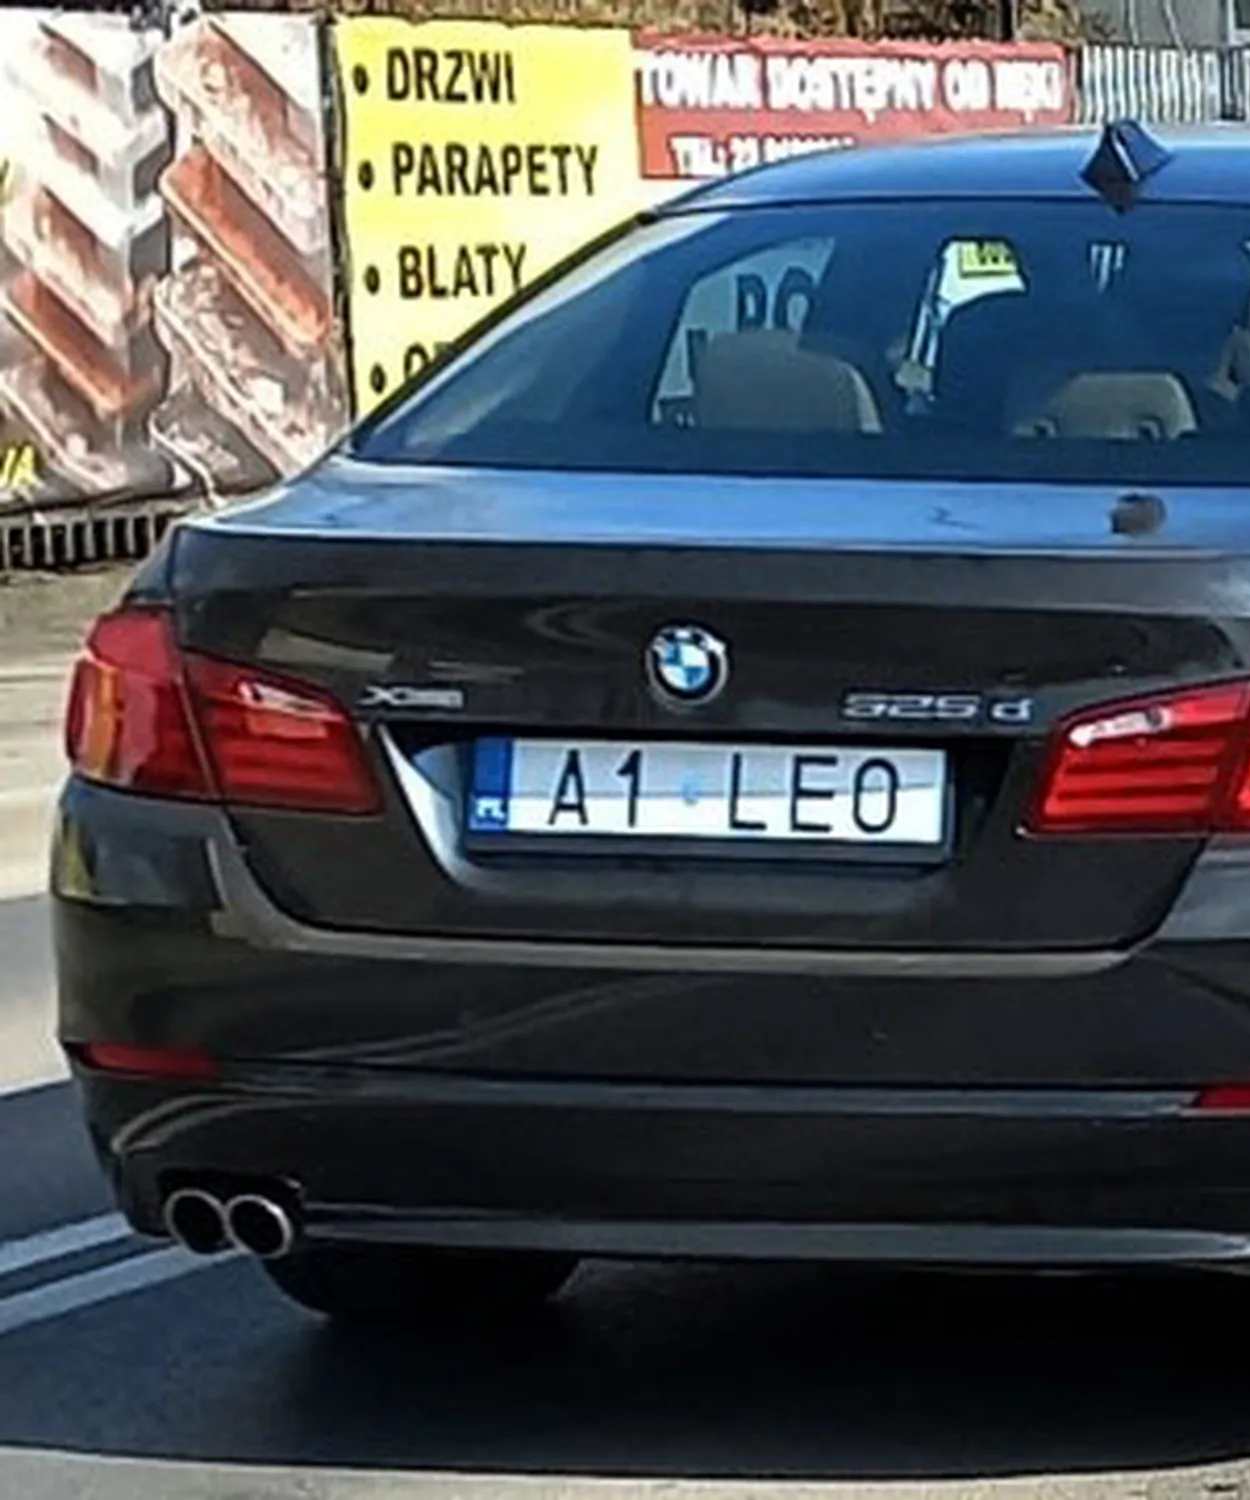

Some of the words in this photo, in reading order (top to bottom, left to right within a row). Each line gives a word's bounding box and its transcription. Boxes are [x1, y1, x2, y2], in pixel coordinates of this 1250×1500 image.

[386, 46, 516, 103] DRZWI
[633, 48, 762, 111] TOWAR
[392, 141, 598, 196] PARAPETY
[398, 242, 527, 299] BLATY
[548, 748, 642, 827] A1
[729, 752, 899, 834] LEO
